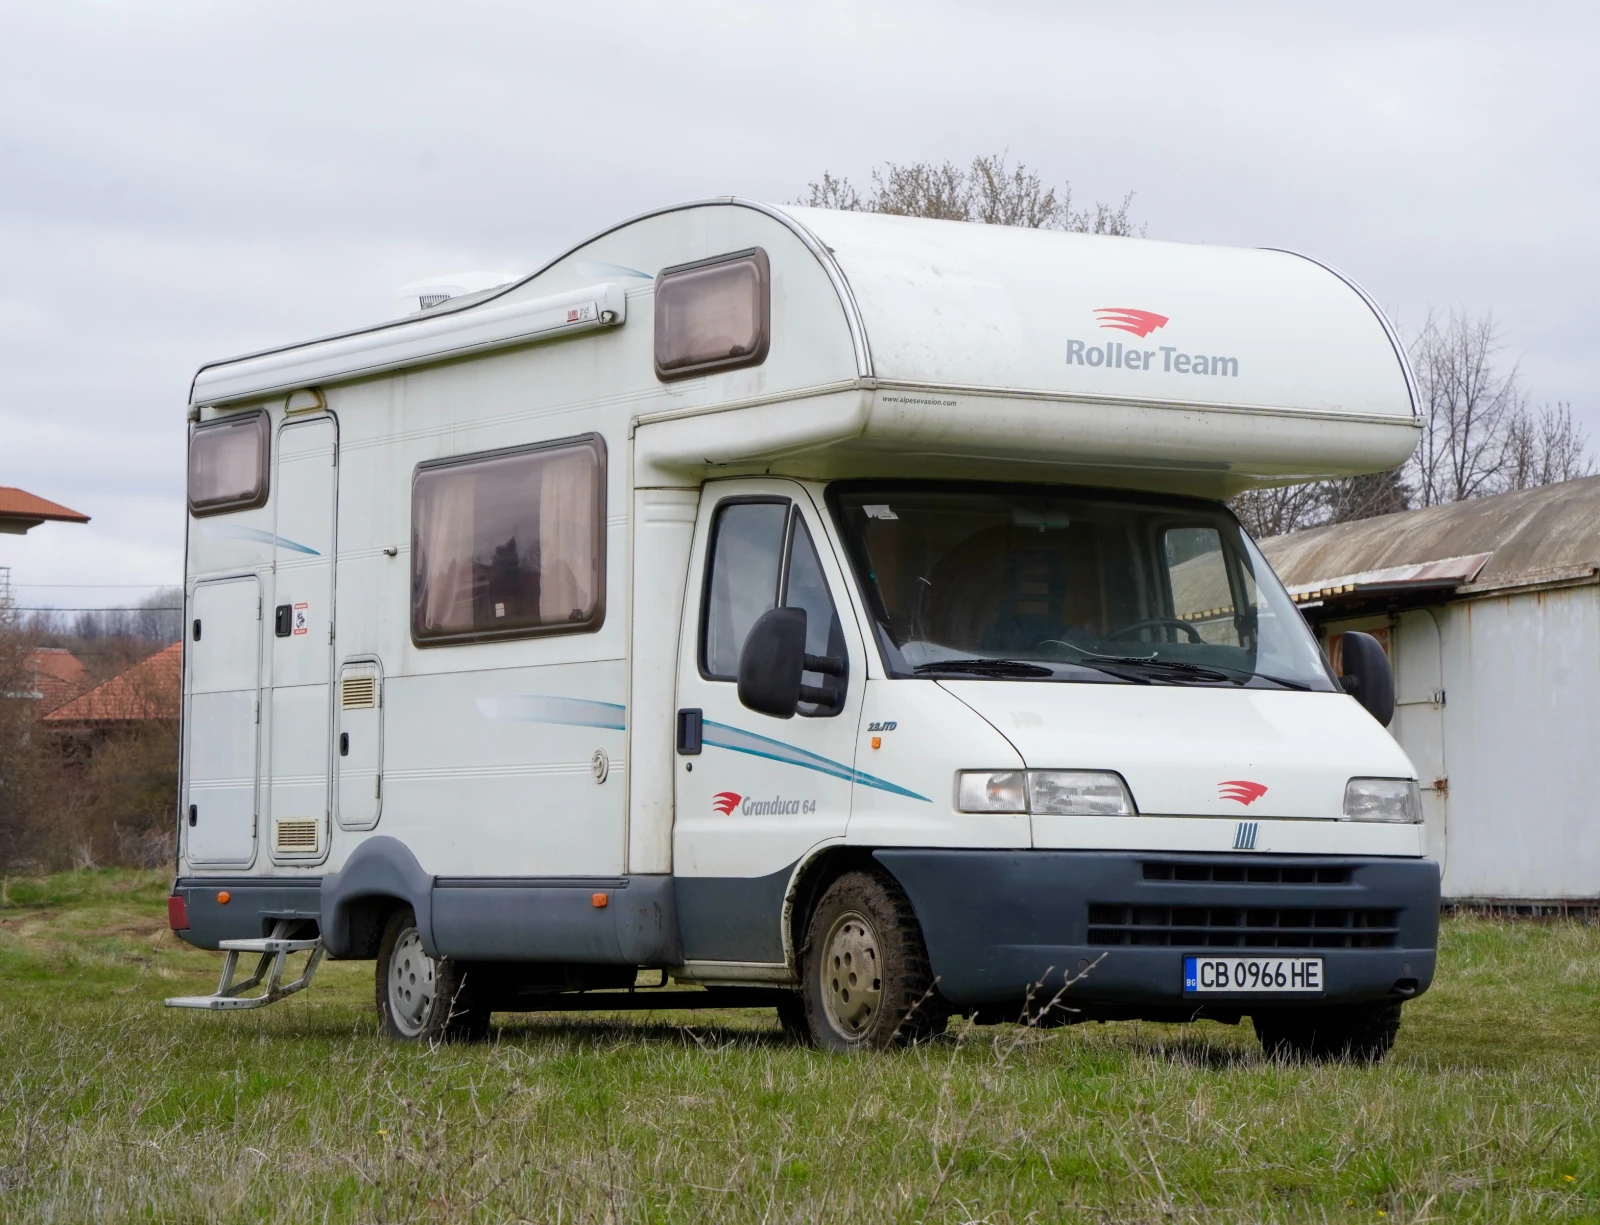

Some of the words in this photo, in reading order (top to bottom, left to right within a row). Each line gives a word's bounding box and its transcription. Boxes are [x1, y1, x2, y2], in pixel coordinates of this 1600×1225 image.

[1065, 339, 1156, 371] Roller
[1159, 346, 1239, 377] Team
[882, 396, 957, 407] www.alpesevasion.com
[741, 795, 800, 816] Granduca
[802, 799, 816, 815] 64
[1186, 978, 1196, 987] BG
[1234, 961, 1287, 988] 0966
